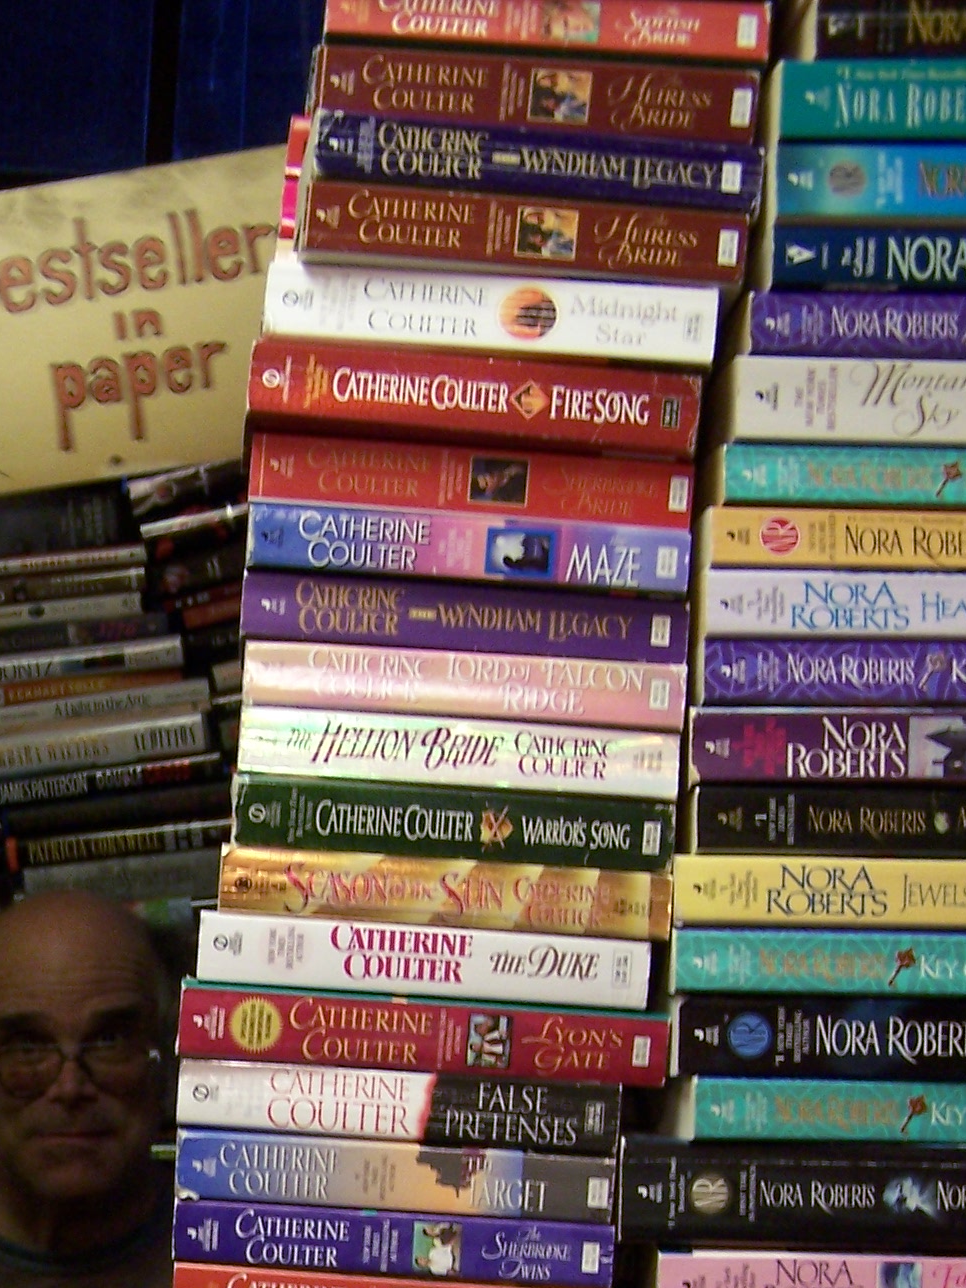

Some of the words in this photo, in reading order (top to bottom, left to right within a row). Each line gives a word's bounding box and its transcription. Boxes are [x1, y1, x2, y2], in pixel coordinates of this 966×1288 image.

[518, 147, 626, 179] WYNDHAM
[112, 309, 162, 341] in
[832, 306, 889, 342] NORA
[49, 342, 228, 452] paper
[298, 512, 433, 551] CATHERINE
[307, 538, 418, 572] COULTER
[564, 544, 641, 593] MAZE
[804, 581, 899, 606] NORA
[790, 604, 912, 633] ROBERTS
[822, 716, 907, 747] NORA
[786, 743, 908, 780] ROBERTS
[589, 820, 631, 854] SONG
[780, 863, 875, 890] NORA
[766, 888, 888, 918] ROBERTS
[329, 924, 475, 961] CATHERINE
[342, 951, 464, 984] COULTER
[527, 942, 600, 982] DUKE
[287, 1001, 434, 1038] CATHERINE
[299, 1029, 419, 1064] COULTER
[815, 1014, 880, 1060] NORA
[479, 1081, 548, 1113] FALSE
[442, 1112, 578, 1147] PRETENSES
[233, 1208, 351, 1243] CATHERINE
[244, 1236, 340, 1268] COULTER
